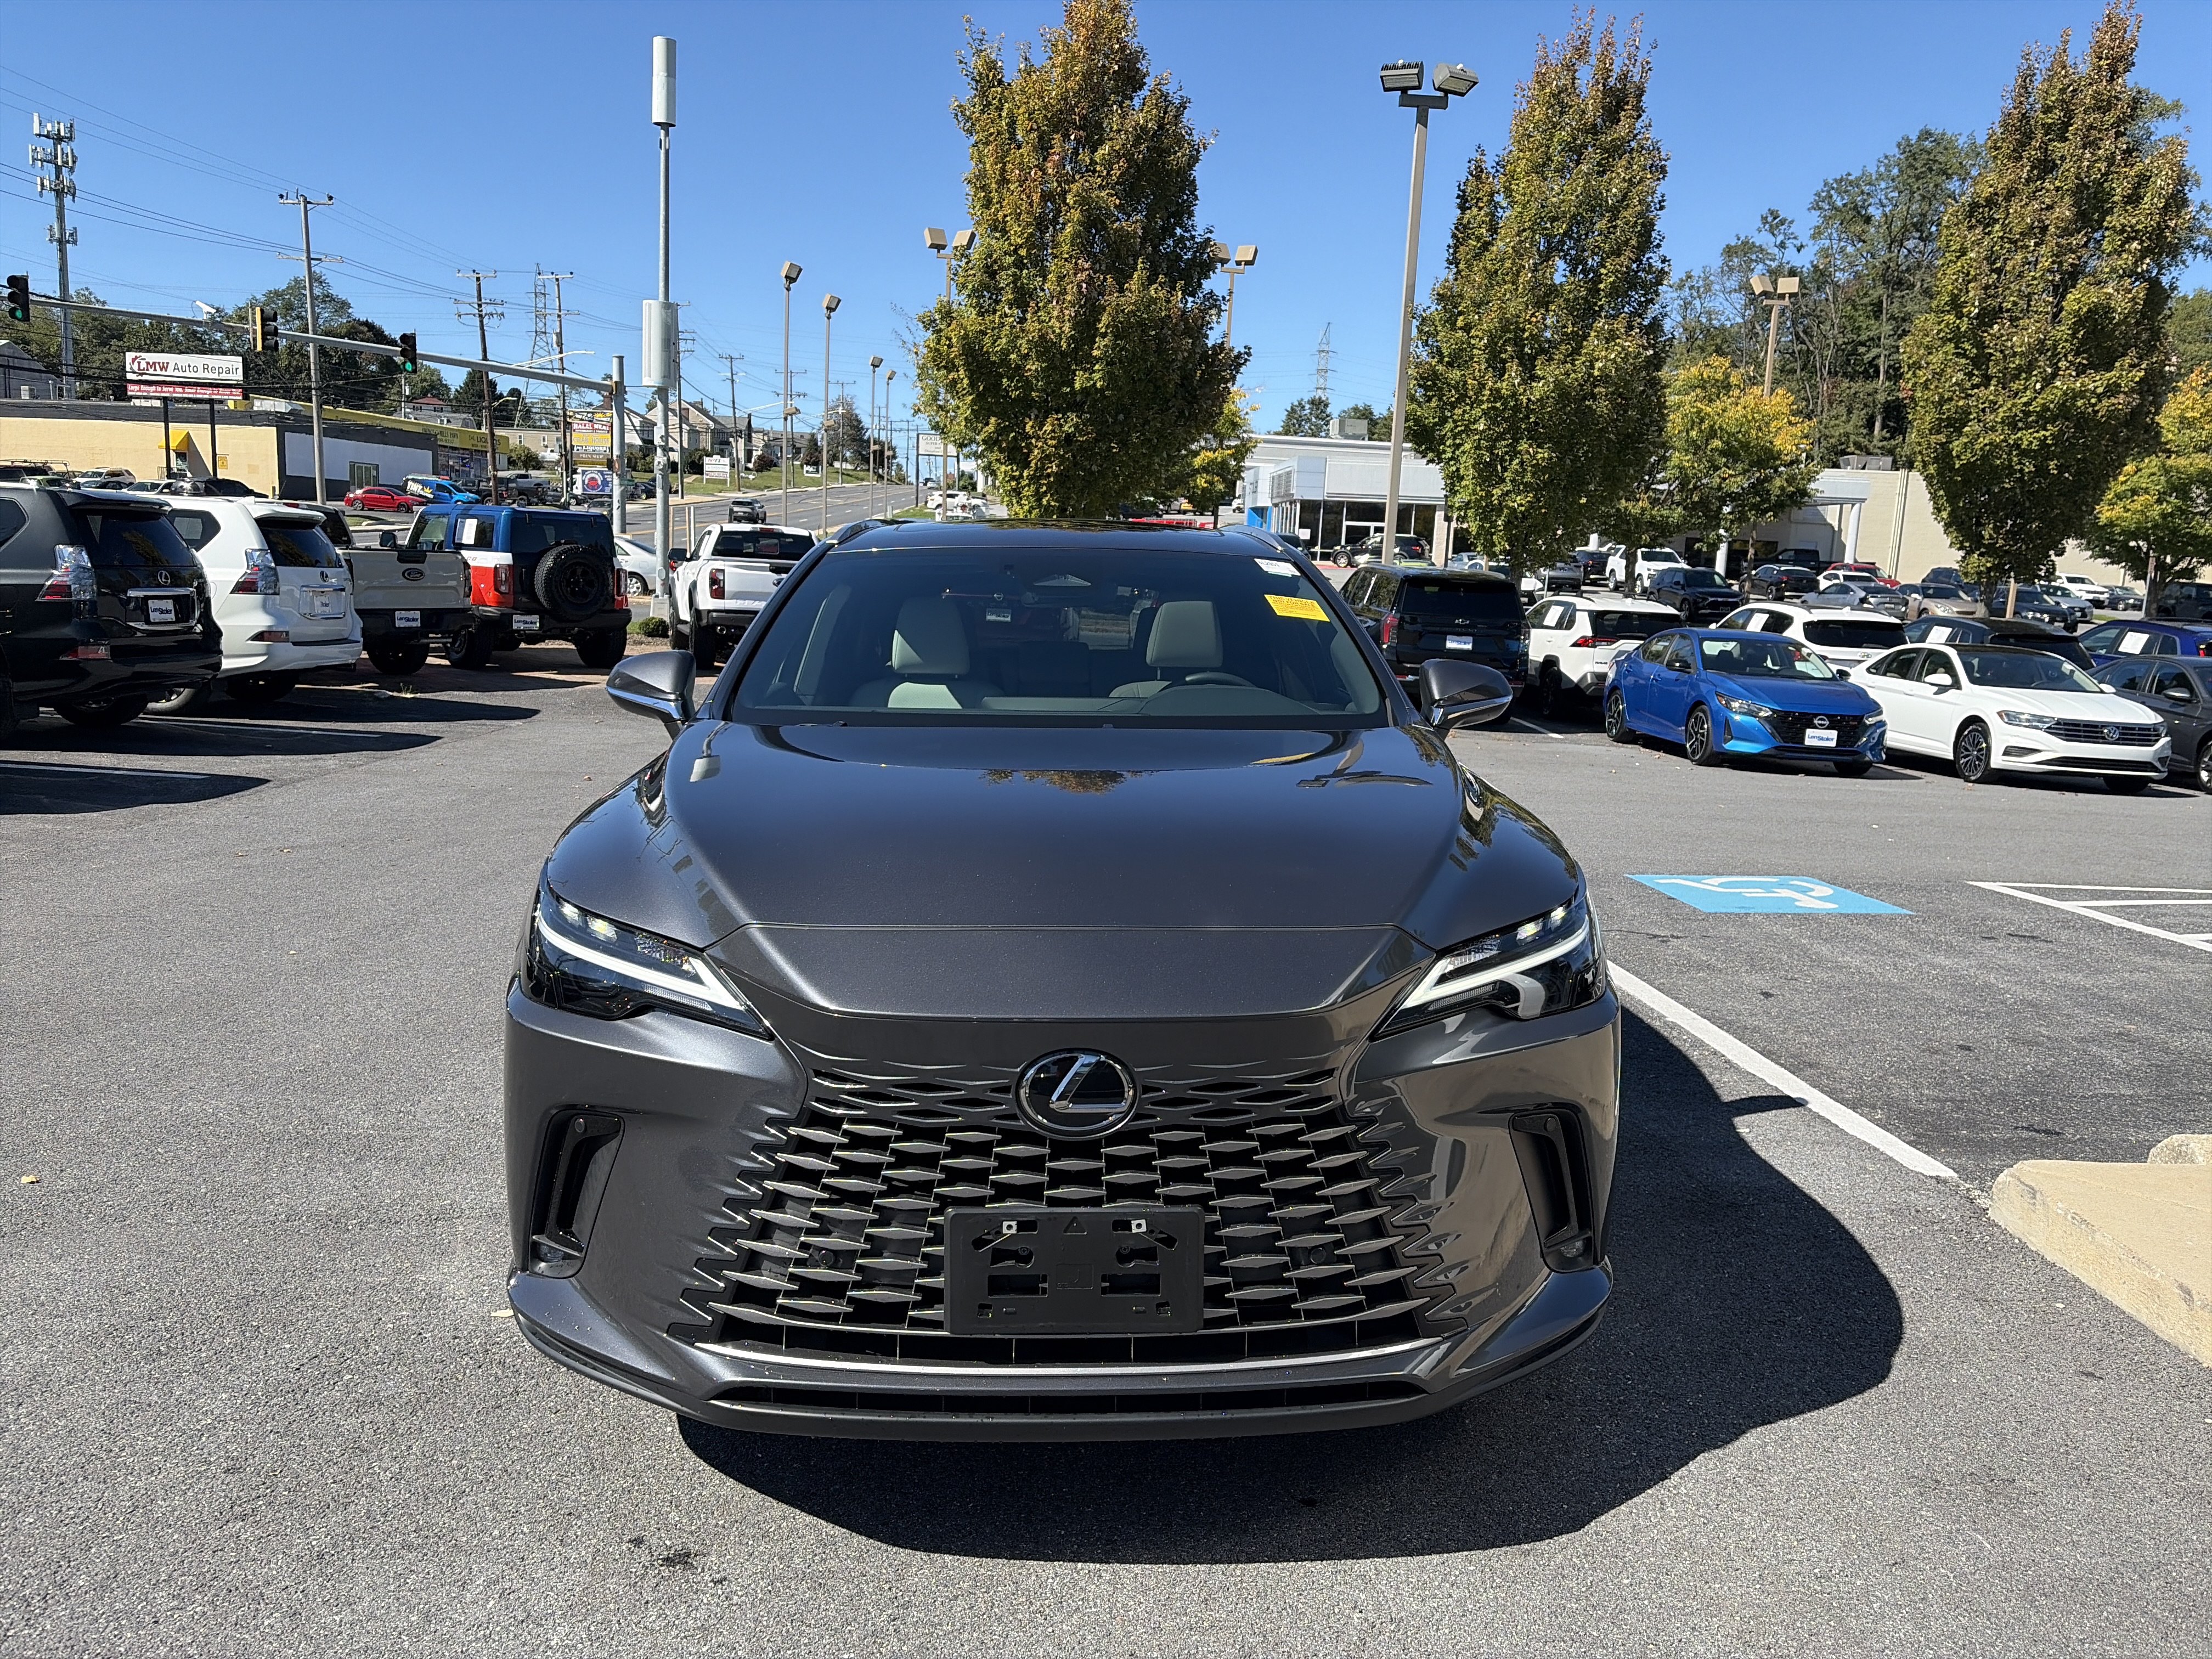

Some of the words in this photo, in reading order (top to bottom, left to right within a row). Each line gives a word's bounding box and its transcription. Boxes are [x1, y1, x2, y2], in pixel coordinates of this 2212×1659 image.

[137, 361, 170, 373] LMW
[173, 362, 199, 373] Auto
[202, 363, 240, 377] Repair
